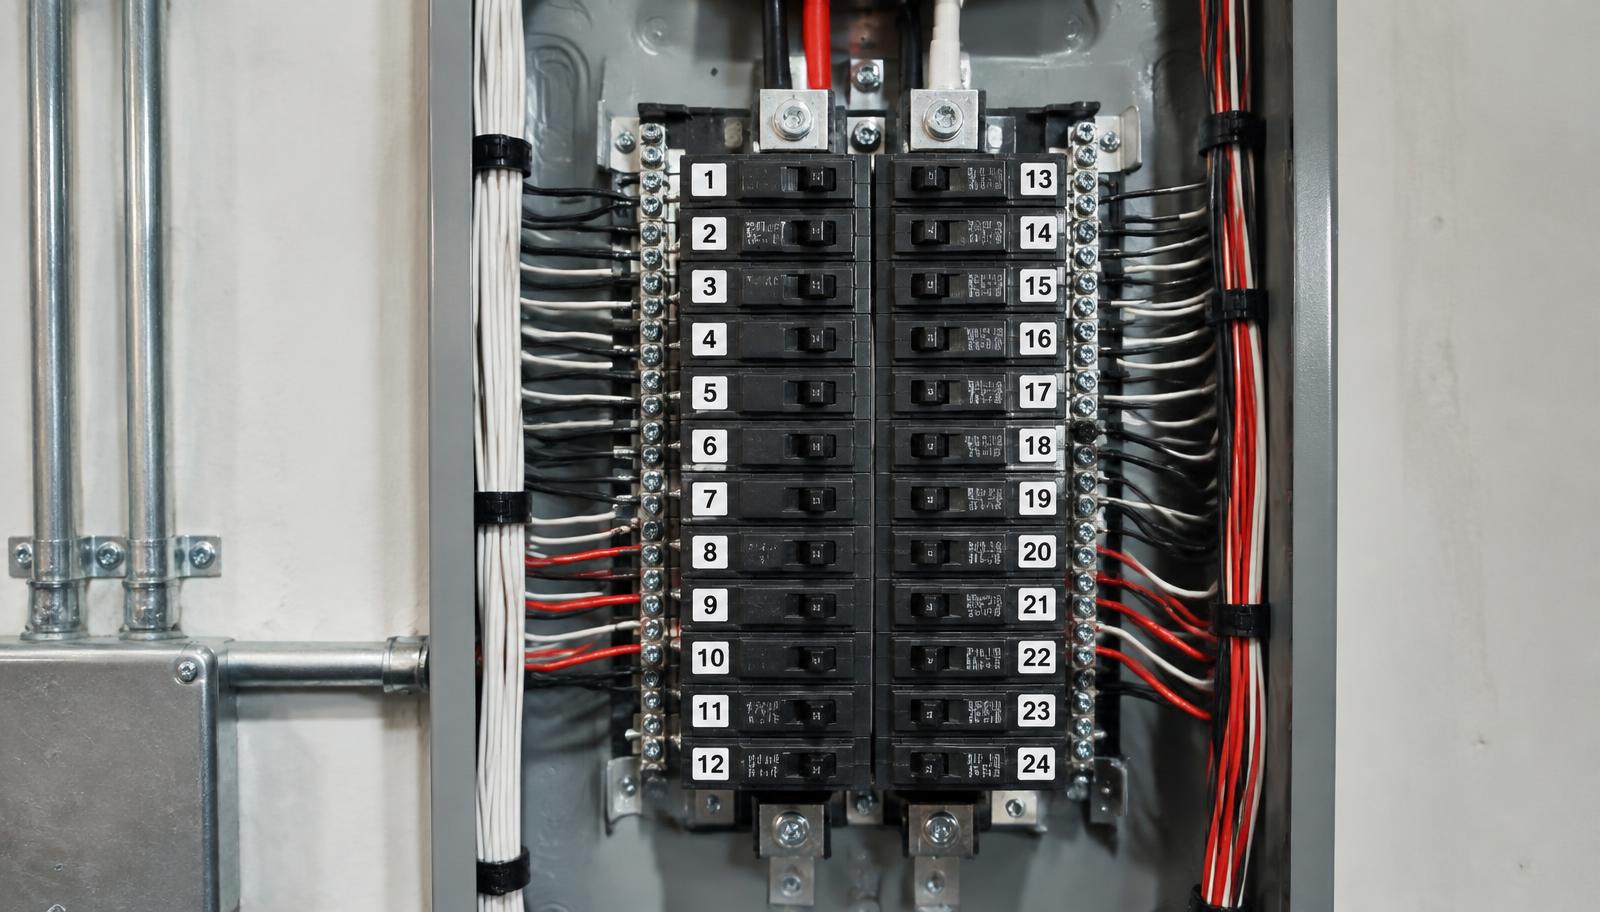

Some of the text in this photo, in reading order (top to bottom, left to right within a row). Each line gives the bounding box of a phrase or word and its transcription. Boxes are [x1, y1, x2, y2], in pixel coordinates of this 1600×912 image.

[704, 169, 713, 190] 1
[1025, 169, 1052, 189] 13
[702, 223, 717, 244] 2
[1025, 222, 1052, 243] 14
[702, 276, 717, 297] 3
[1025, 276, 1052, 296] 15
[702, 329, 717, 349] 4
[1025, 328, 1052, 349] 16
[703, 382, 717, 403] 5
[1024, 382, 1052, 402] 17
[702, 435, 718, 456] 6
[1024, 435, 1052, 456] 18
[703, 489, 718, 509] 7
[1024, 488, 1052, 509] 19
[703, 542, 717, 562] 8
[1023, 541, 1052, 562] 20
[703, 595, 718, 615] 9
[1023, 594, 1047, 614] 21
[697, 648, 725, 668] 10
[1023, 647, 1051, 667] 22
[698, 701, 721, 721] 11
[1022, 700, 1050, 721] 23
[697, 754, 724, 774] 12
[1022, 753, 1051, 774] 24
